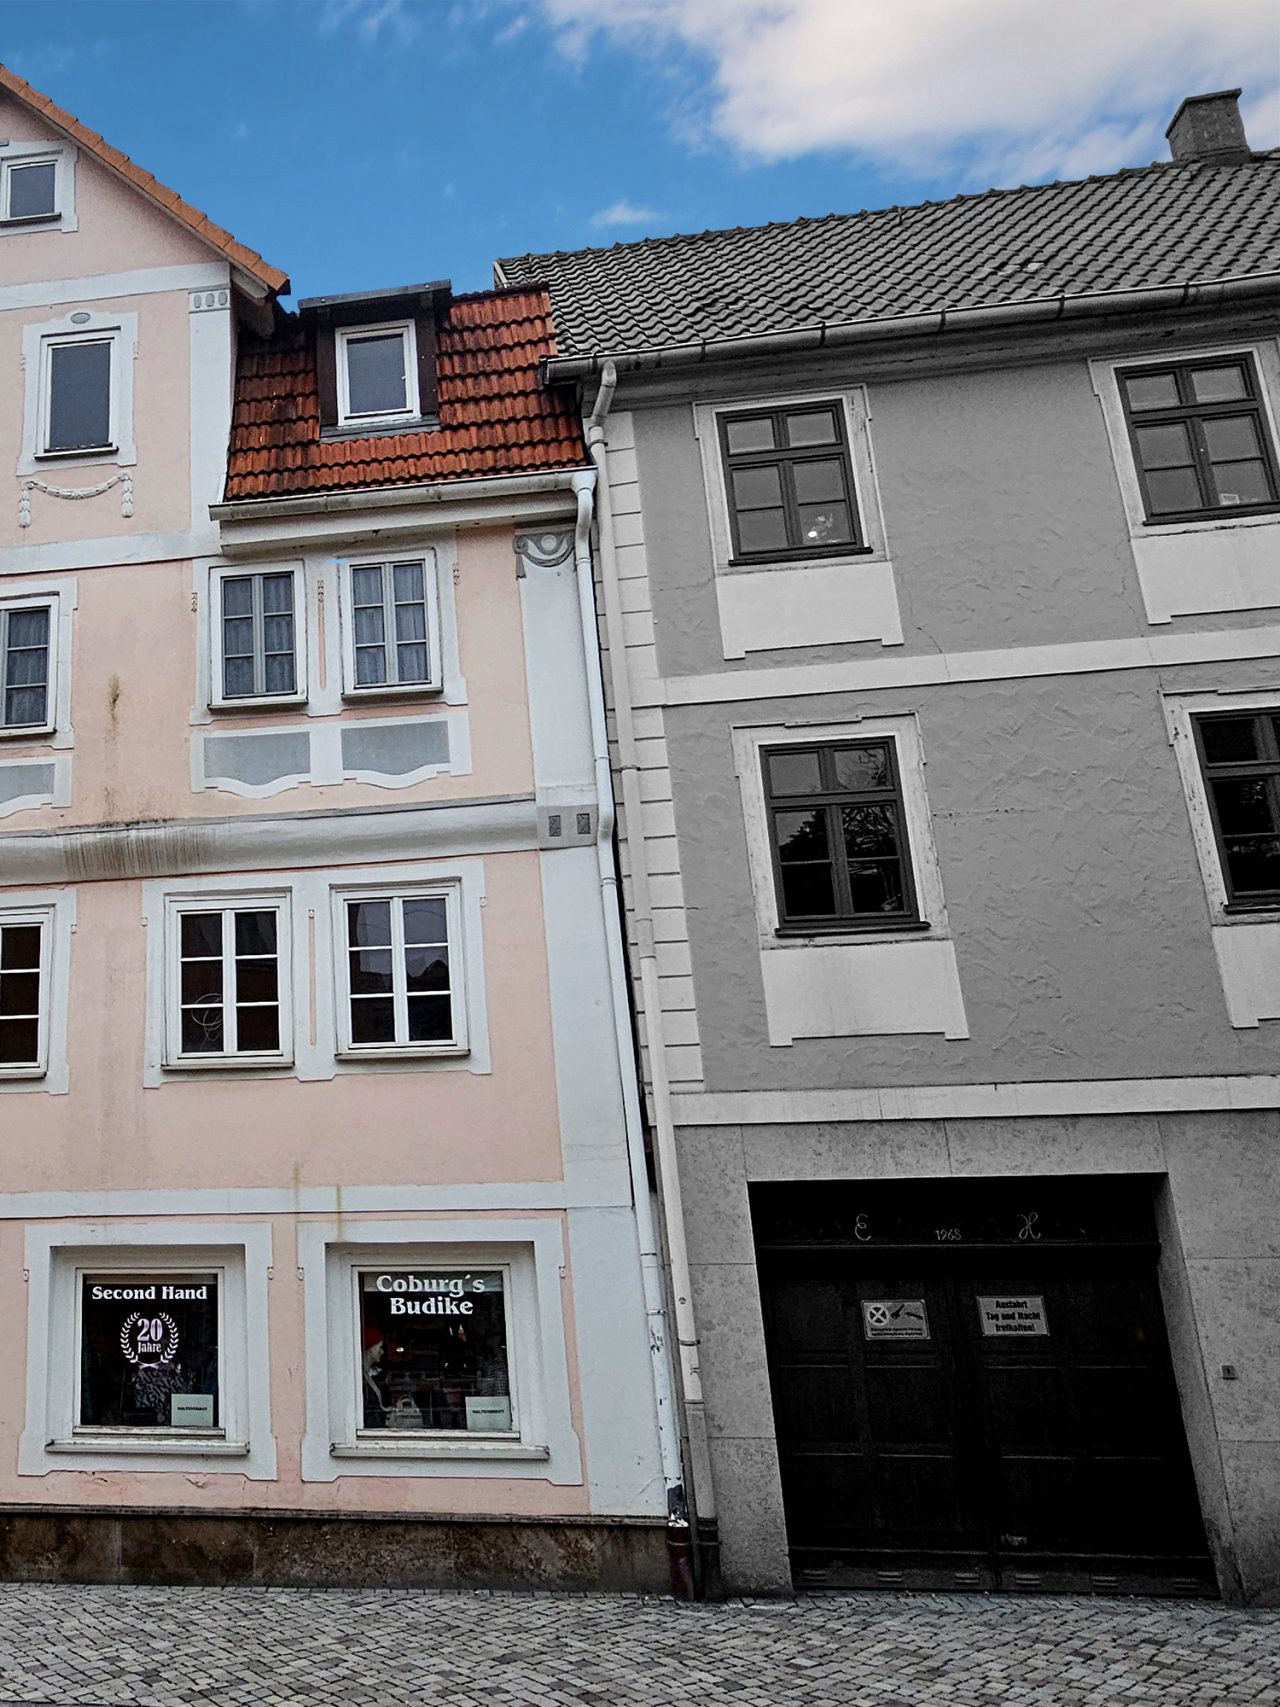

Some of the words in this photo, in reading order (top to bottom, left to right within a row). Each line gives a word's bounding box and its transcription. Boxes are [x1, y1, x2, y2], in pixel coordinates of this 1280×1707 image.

[92, 1286, 156, 1300] Second
[162, 1286, 208, 1300] Hand
[390, 1297, 474, 1315] Budike
[985, 1311, 1000, 1321] Tag
[1001, 1312, 1016, 1320] und
[1017, 1312, 1041, 1320] Nacht
[136, 1318, 163, 1342] 20
[137, 1341, 162, 1354] Jahre
